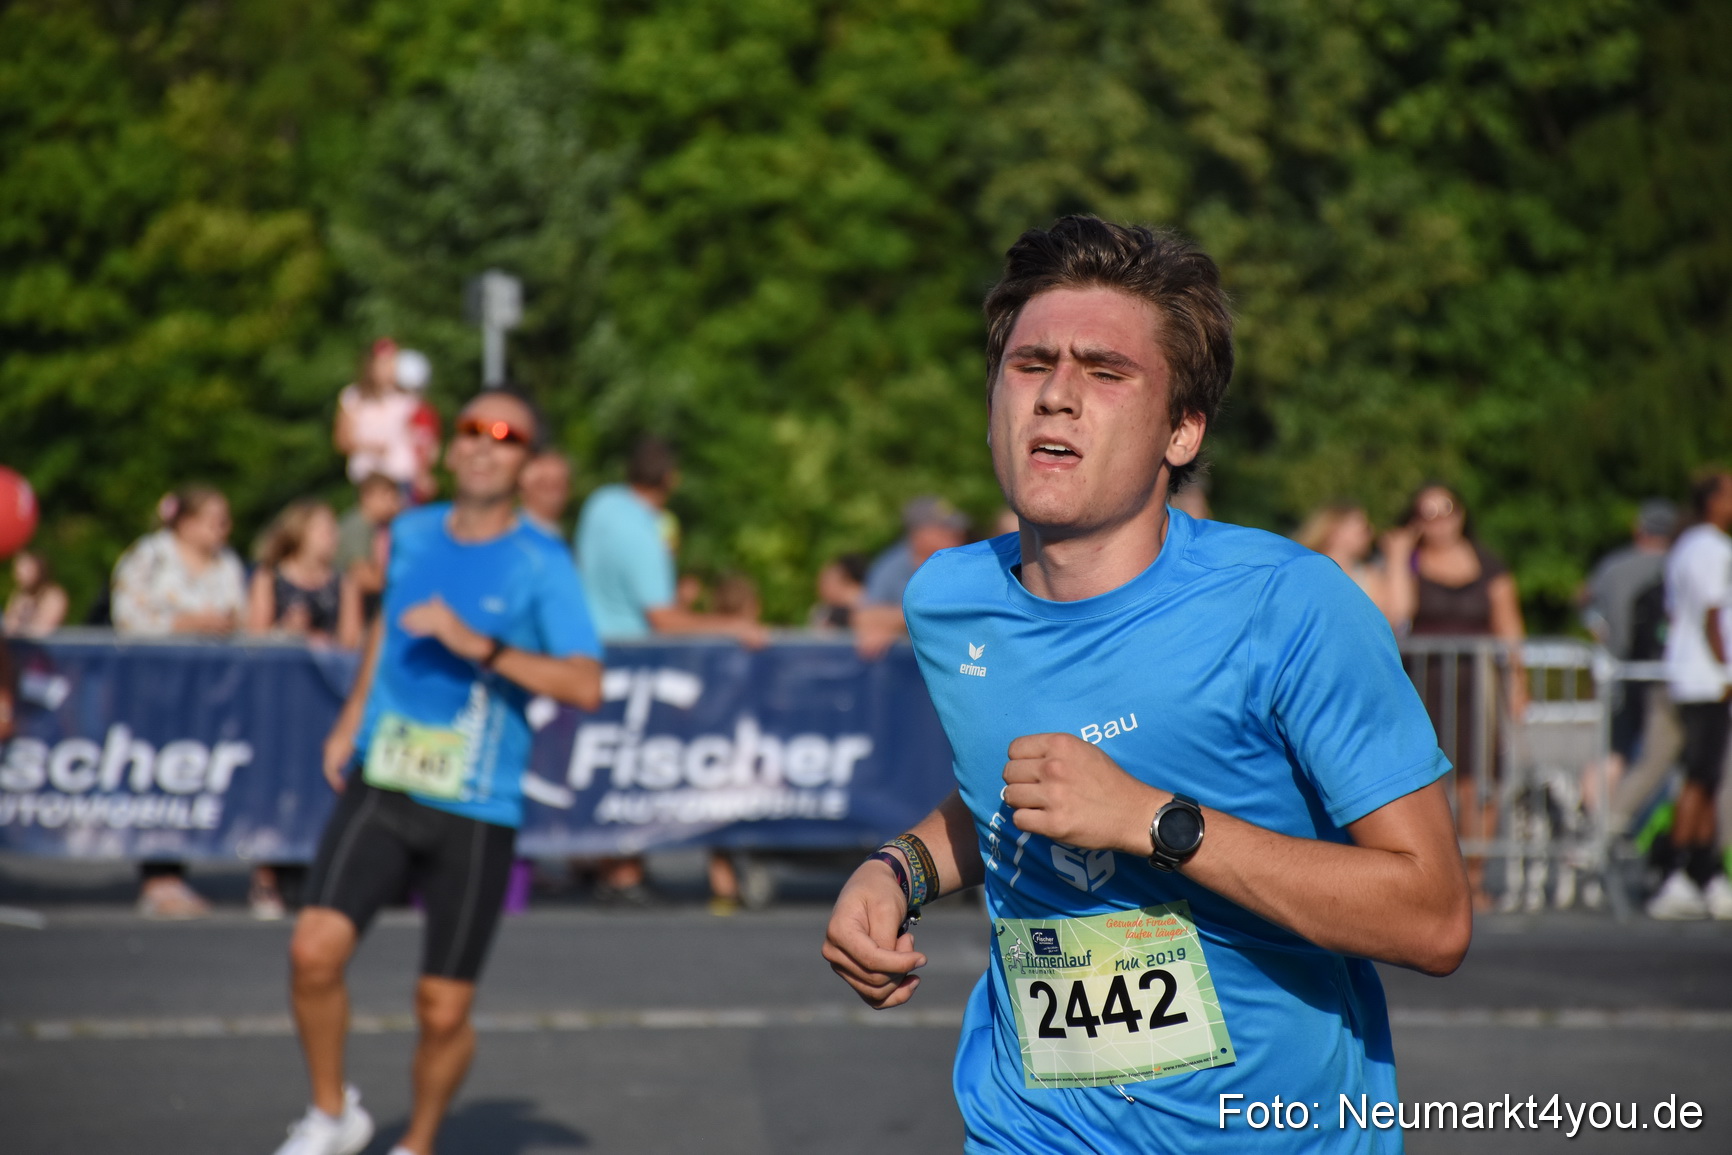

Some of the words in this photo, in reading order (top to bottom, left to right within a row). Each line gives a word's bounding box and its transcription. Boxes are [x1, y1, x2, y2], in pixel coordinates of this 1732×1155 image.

[959, 662, 987, 677] erima
[1080, 713, 1139, 745] Bau
[568, 712, 873, 789] Fischer
[1106, 917, 1144, 928] Gesunde
[1146, 917, 1178, 927] Firmen
[1125, 929, 1152, 940] laufen
[1025, 950, 1092, 968] firmenlauf
[1115, 957, 1140, 971] run
[1146, 948, 1187, 968] 2019
[1029, 969, 1189, 1039] 2442
